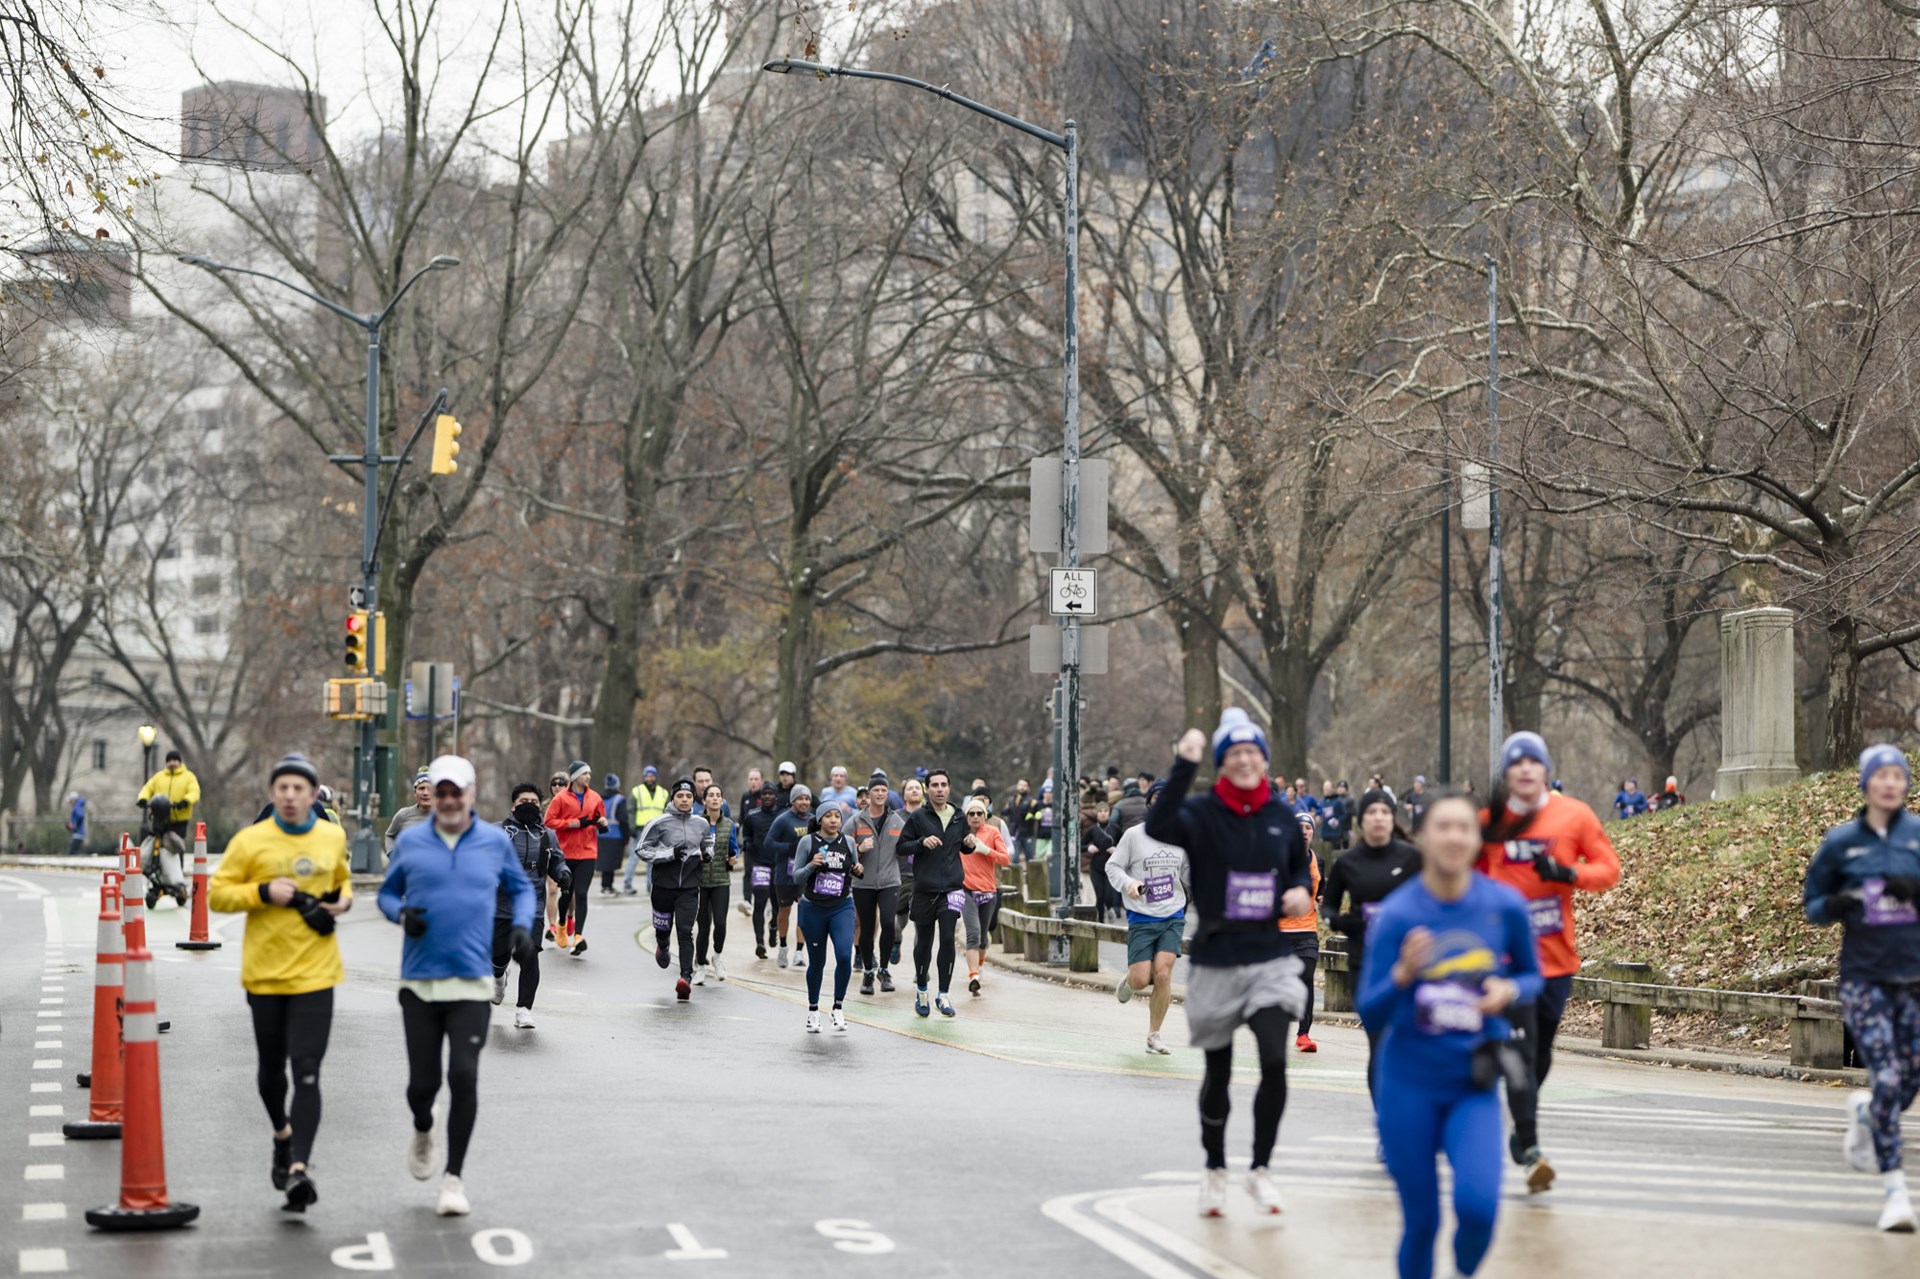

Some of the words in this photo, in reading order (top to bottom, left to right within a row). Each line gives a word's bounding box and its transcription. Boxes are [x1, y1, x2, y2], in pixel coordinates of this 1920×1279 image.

[1064, 572, 1083, 581] ALL
[823, 879, 842, 890] 1028
[330, 1218, 896, 1271] STOP
